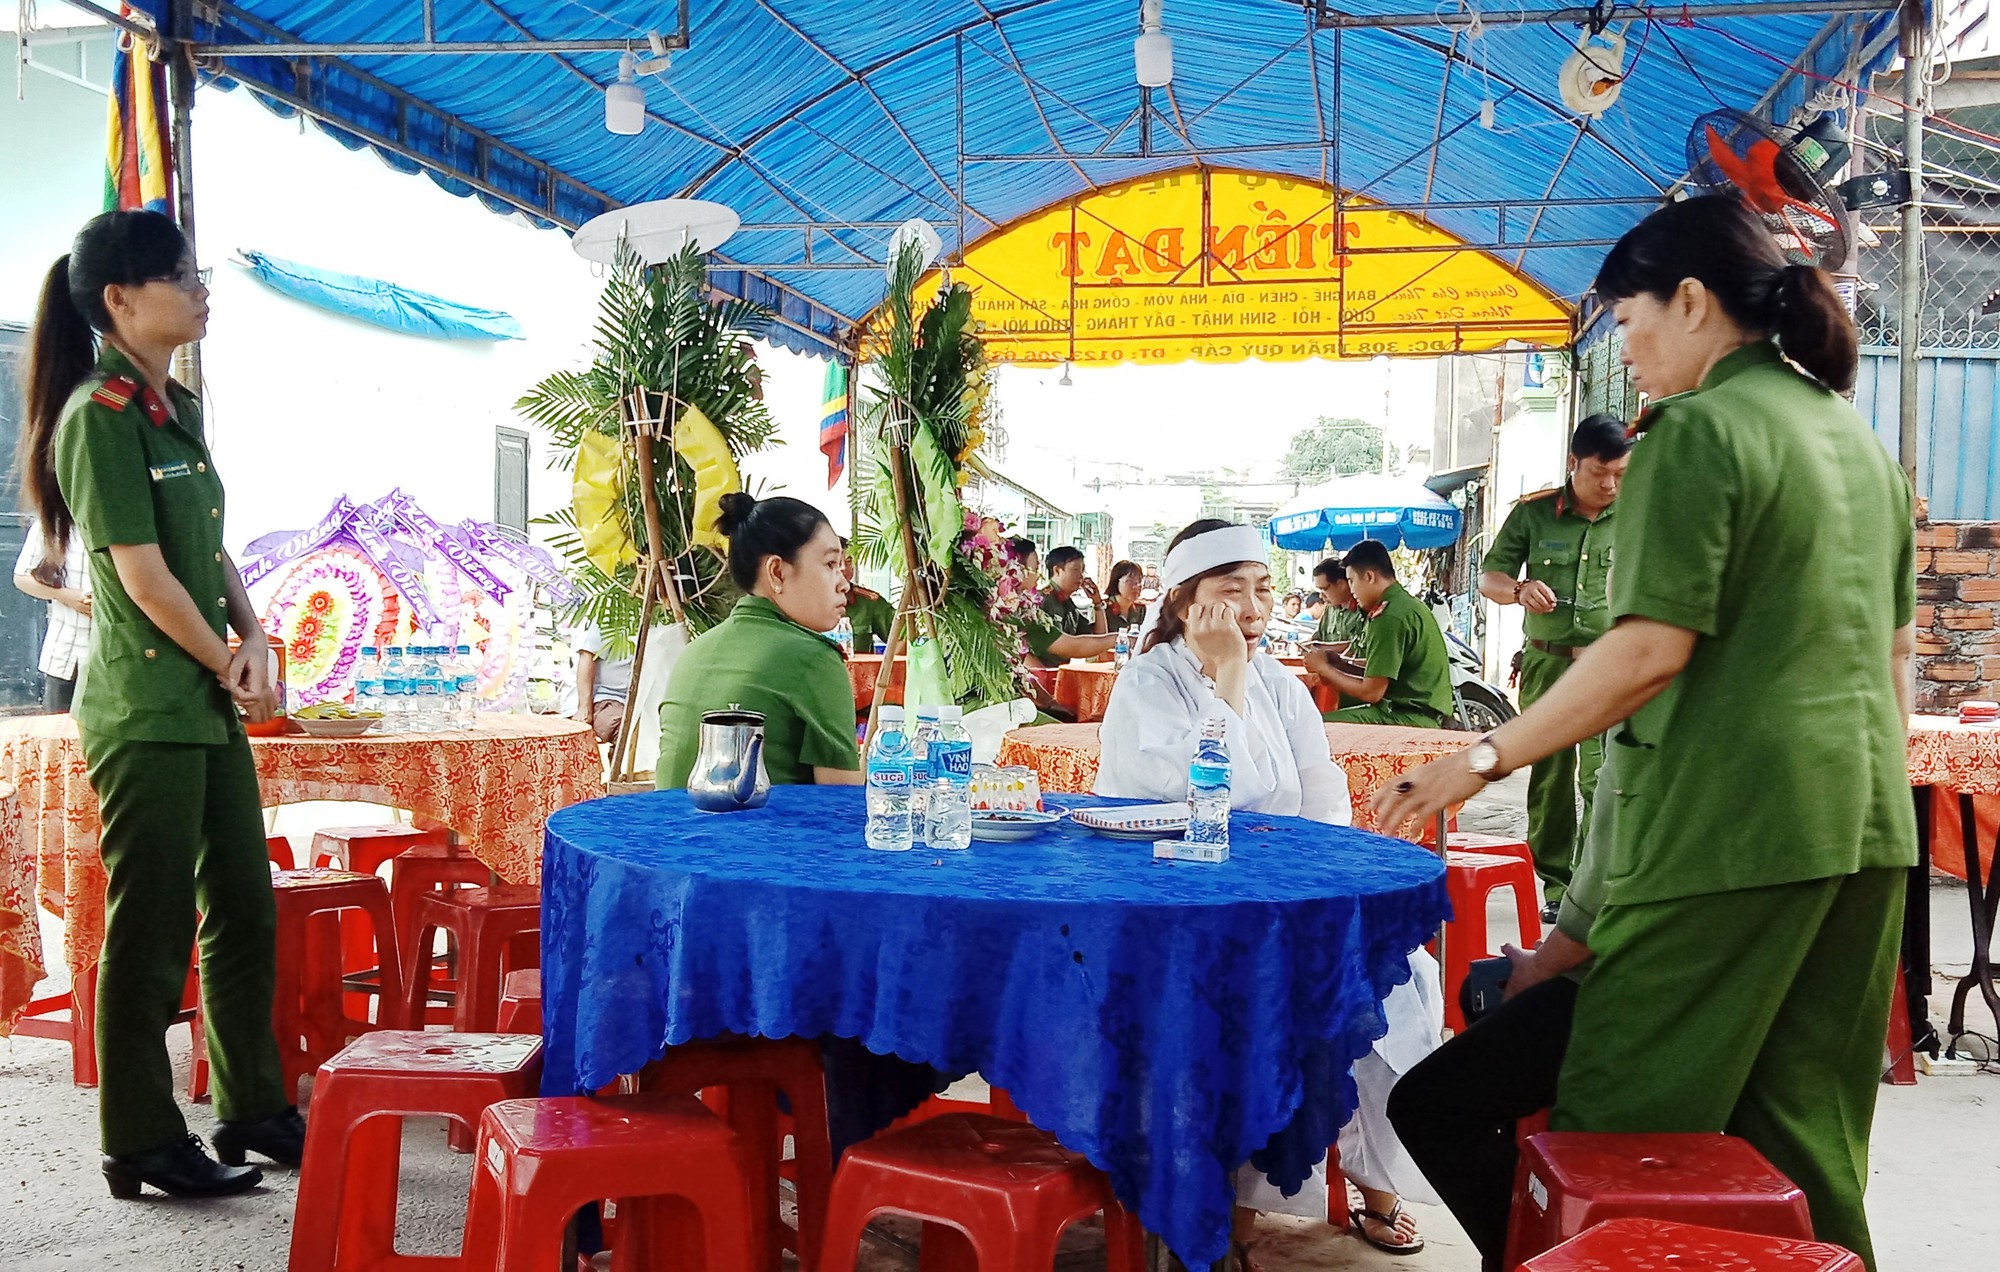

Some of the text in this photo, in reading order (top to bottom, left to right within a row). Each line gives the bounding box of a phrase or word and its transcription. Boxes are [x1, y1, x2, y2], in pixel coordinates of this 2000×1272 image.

[276, 513, 344, 561] Viếng
[347, 520, 390, 562] Kính
[400, 506, 445, 547] Kính
[444, 541, 497, 594] Viếng
[874, 772, 904, 782] suca
